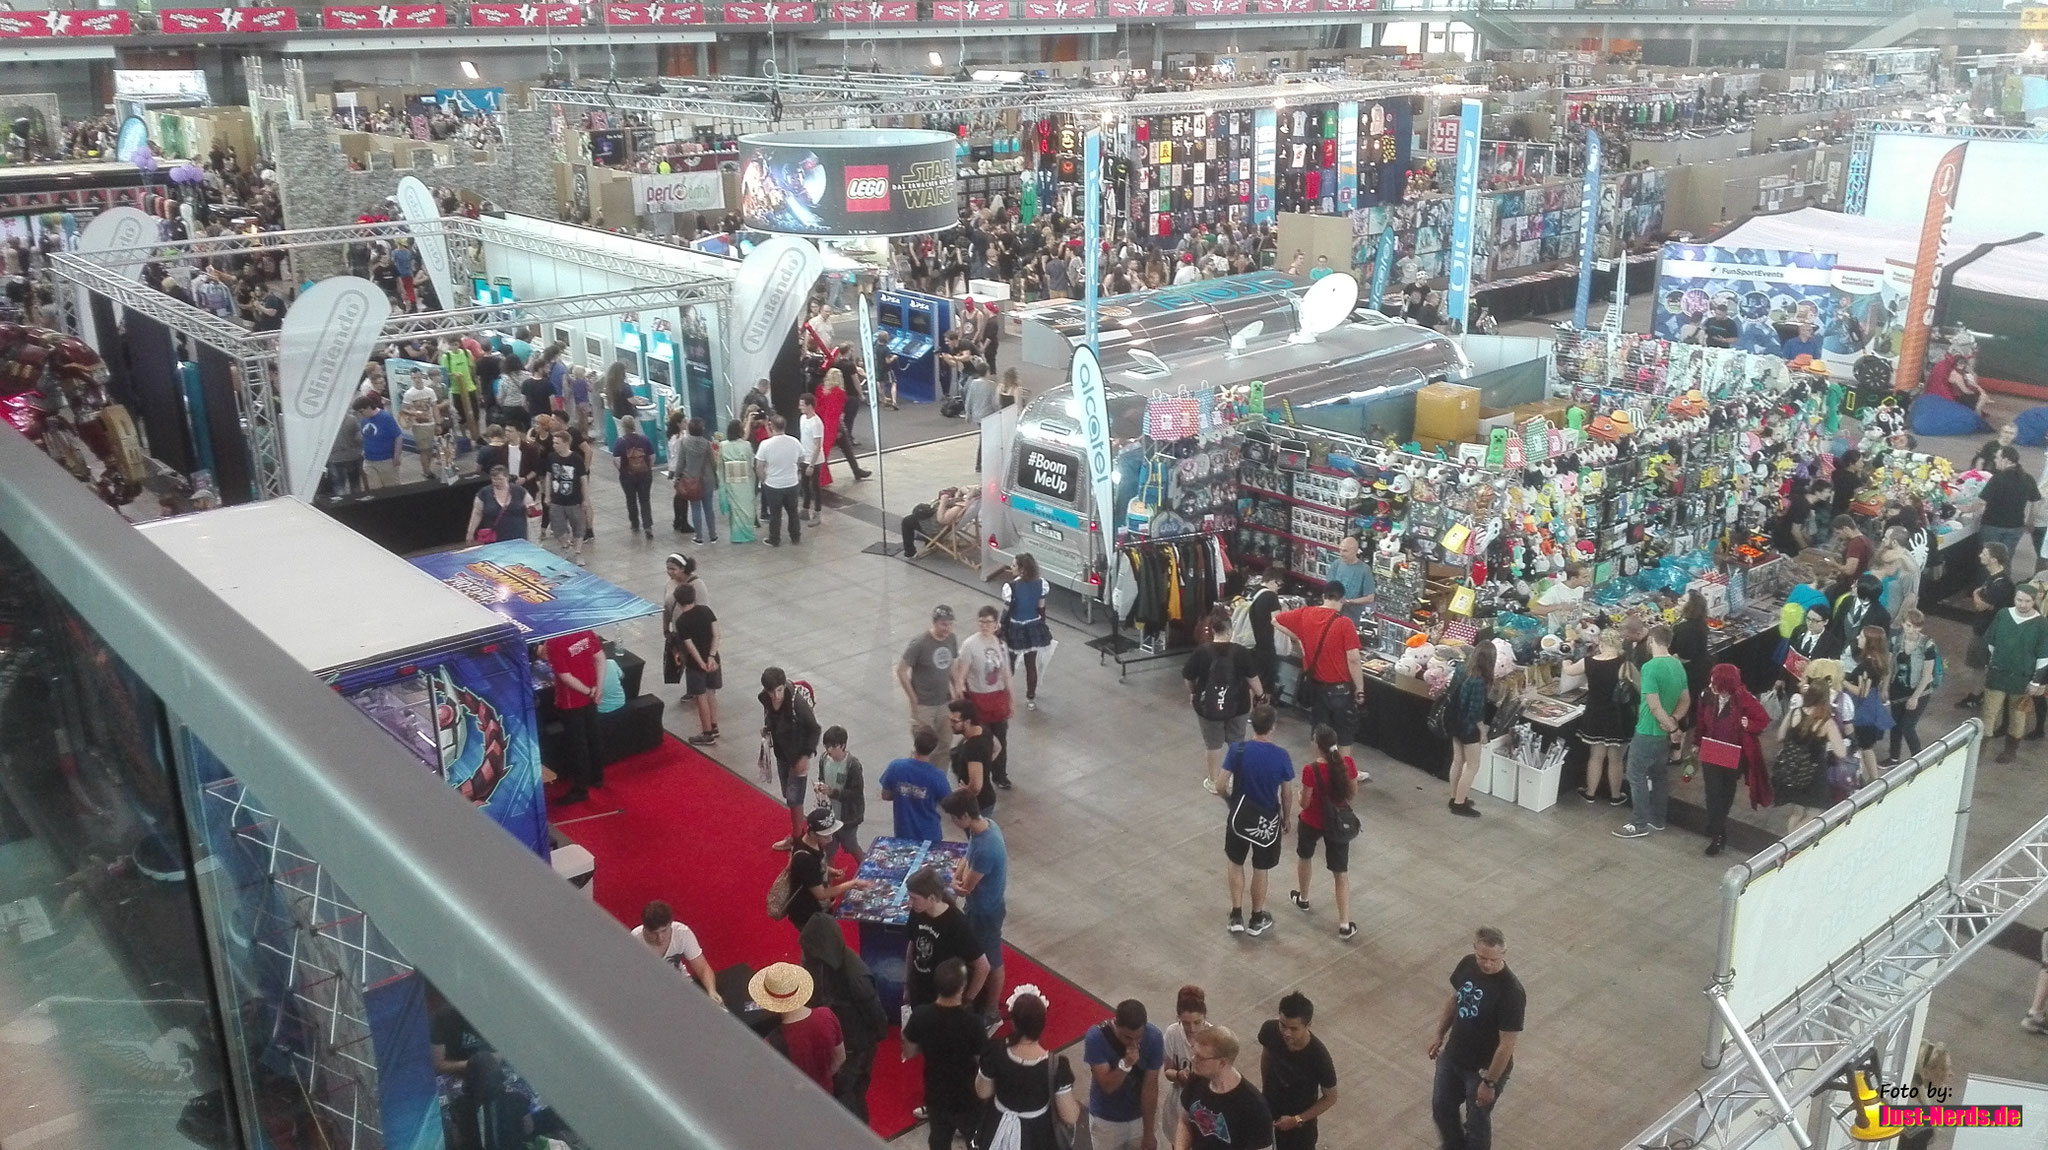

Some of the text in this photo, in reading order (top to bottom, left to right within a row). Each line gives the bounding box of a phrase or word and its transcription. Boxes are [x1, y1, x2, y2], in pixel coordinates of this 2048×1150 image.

[1596, 95, 1628, 103] GAMING
[902, 159, 954, 183] STAR
[848, 178, 889, 199] LEGO
[903, 183, 955, 209] WARS
[1722, 267, 1784, 279] FunSportEvents
[746, 257, 799, 345] Nintendo
[302, 301, 360, 408] Nintendo
[1080, 363, 1109, 484] alcatel
[1028, 451, 1067, 476] #Boom
[1034, 469, 1067, 494] MeUp
